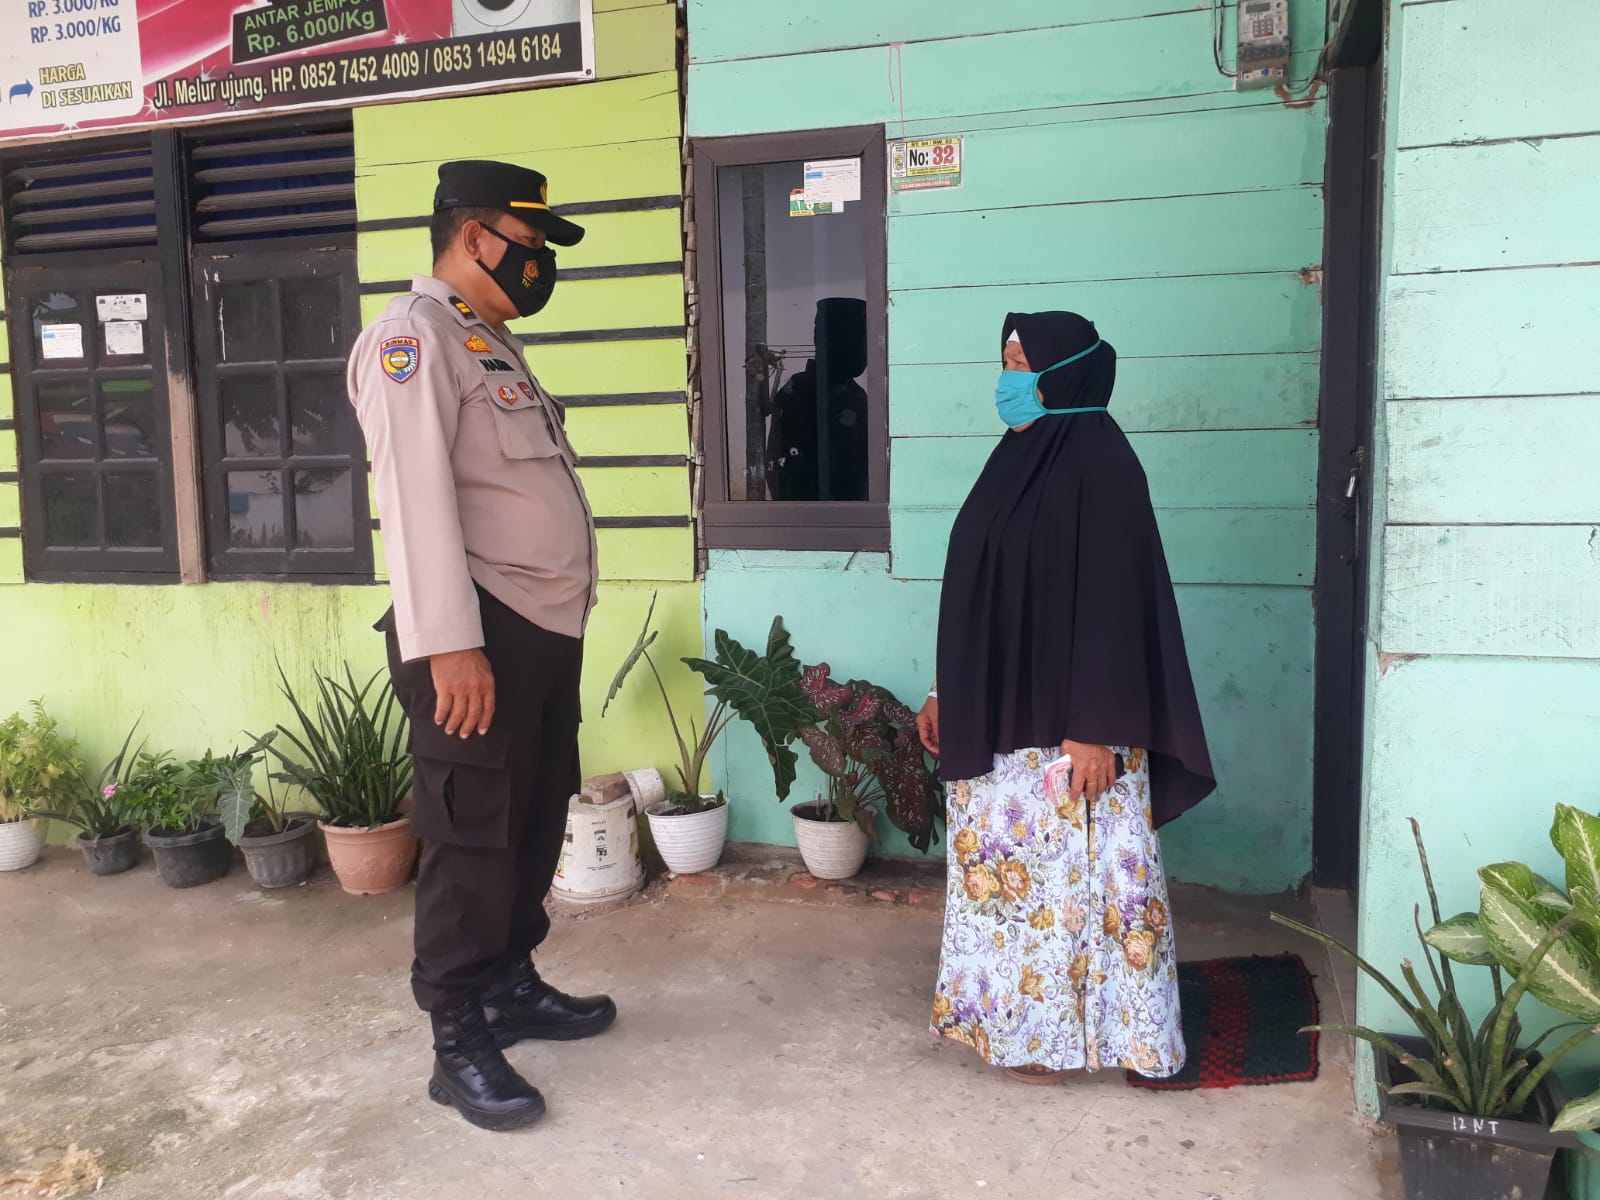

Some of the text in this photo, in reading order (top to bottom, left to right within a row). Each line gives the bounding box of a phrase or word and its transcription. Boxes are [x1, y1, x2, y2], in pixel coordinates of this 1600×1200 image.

[28, 0, 49, 18] RP.
[244, 0, 369, 31] ANTAR JEMP
[31, 16, 121, 44] RP. 3.000/KG
[247, 9, 375, 54] Rp. 6.000/Kg
[39, 62, 86, 85] HARGA
[175, 76, 217, 104] Melur
[220, 74, 267, 104] ujung.
[271, 67, 296, 93] HP.
[300, 61, 337, 89] 0852
[340, 56, 378, 84] 7452
[382, 51, 419, 79] 4009
[433, 44, 472, 73] 0853
[477, 38, 516, 67] 1494
[521, 33, 561, 63] 6184
[41, 81, 133, 109] DI SESUAIKAN
[909, 145, 954, 167] No: 32
[1453, 1116, 1467, 1131] 12
